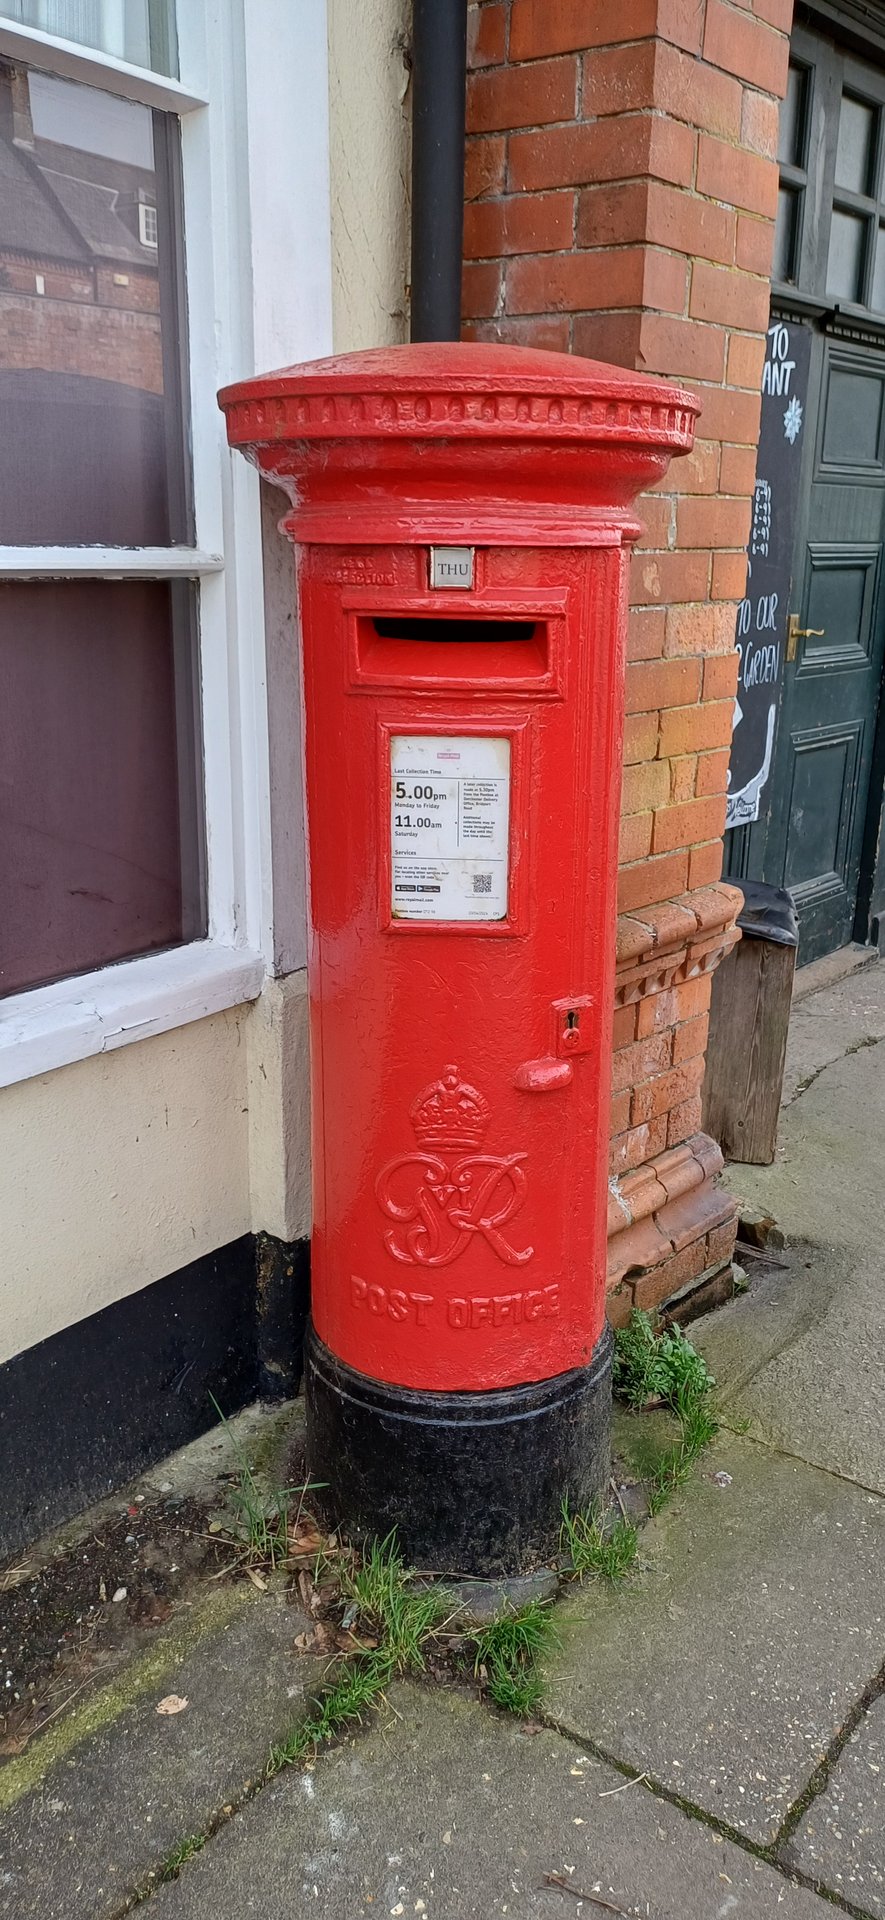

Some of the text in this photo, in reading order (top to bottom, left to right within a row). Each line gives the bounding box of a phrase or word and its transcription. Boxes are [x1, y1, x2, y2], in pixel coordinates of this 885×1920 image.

[768, 323, 789, 361] TO
[762, 361, 796, 396] ANT
[437, 562, 469, 576] THU
[737, 593, 778, 637] TO OUR
[743, 641, 780, 693] GARDEN
[394, 802, 415, 810] Monday
[396, 782, 447, 801] 5.00pm
[395, 815, 442, 828] 11.00am
[350, 1274, 560, 1330] POST OFFICE
